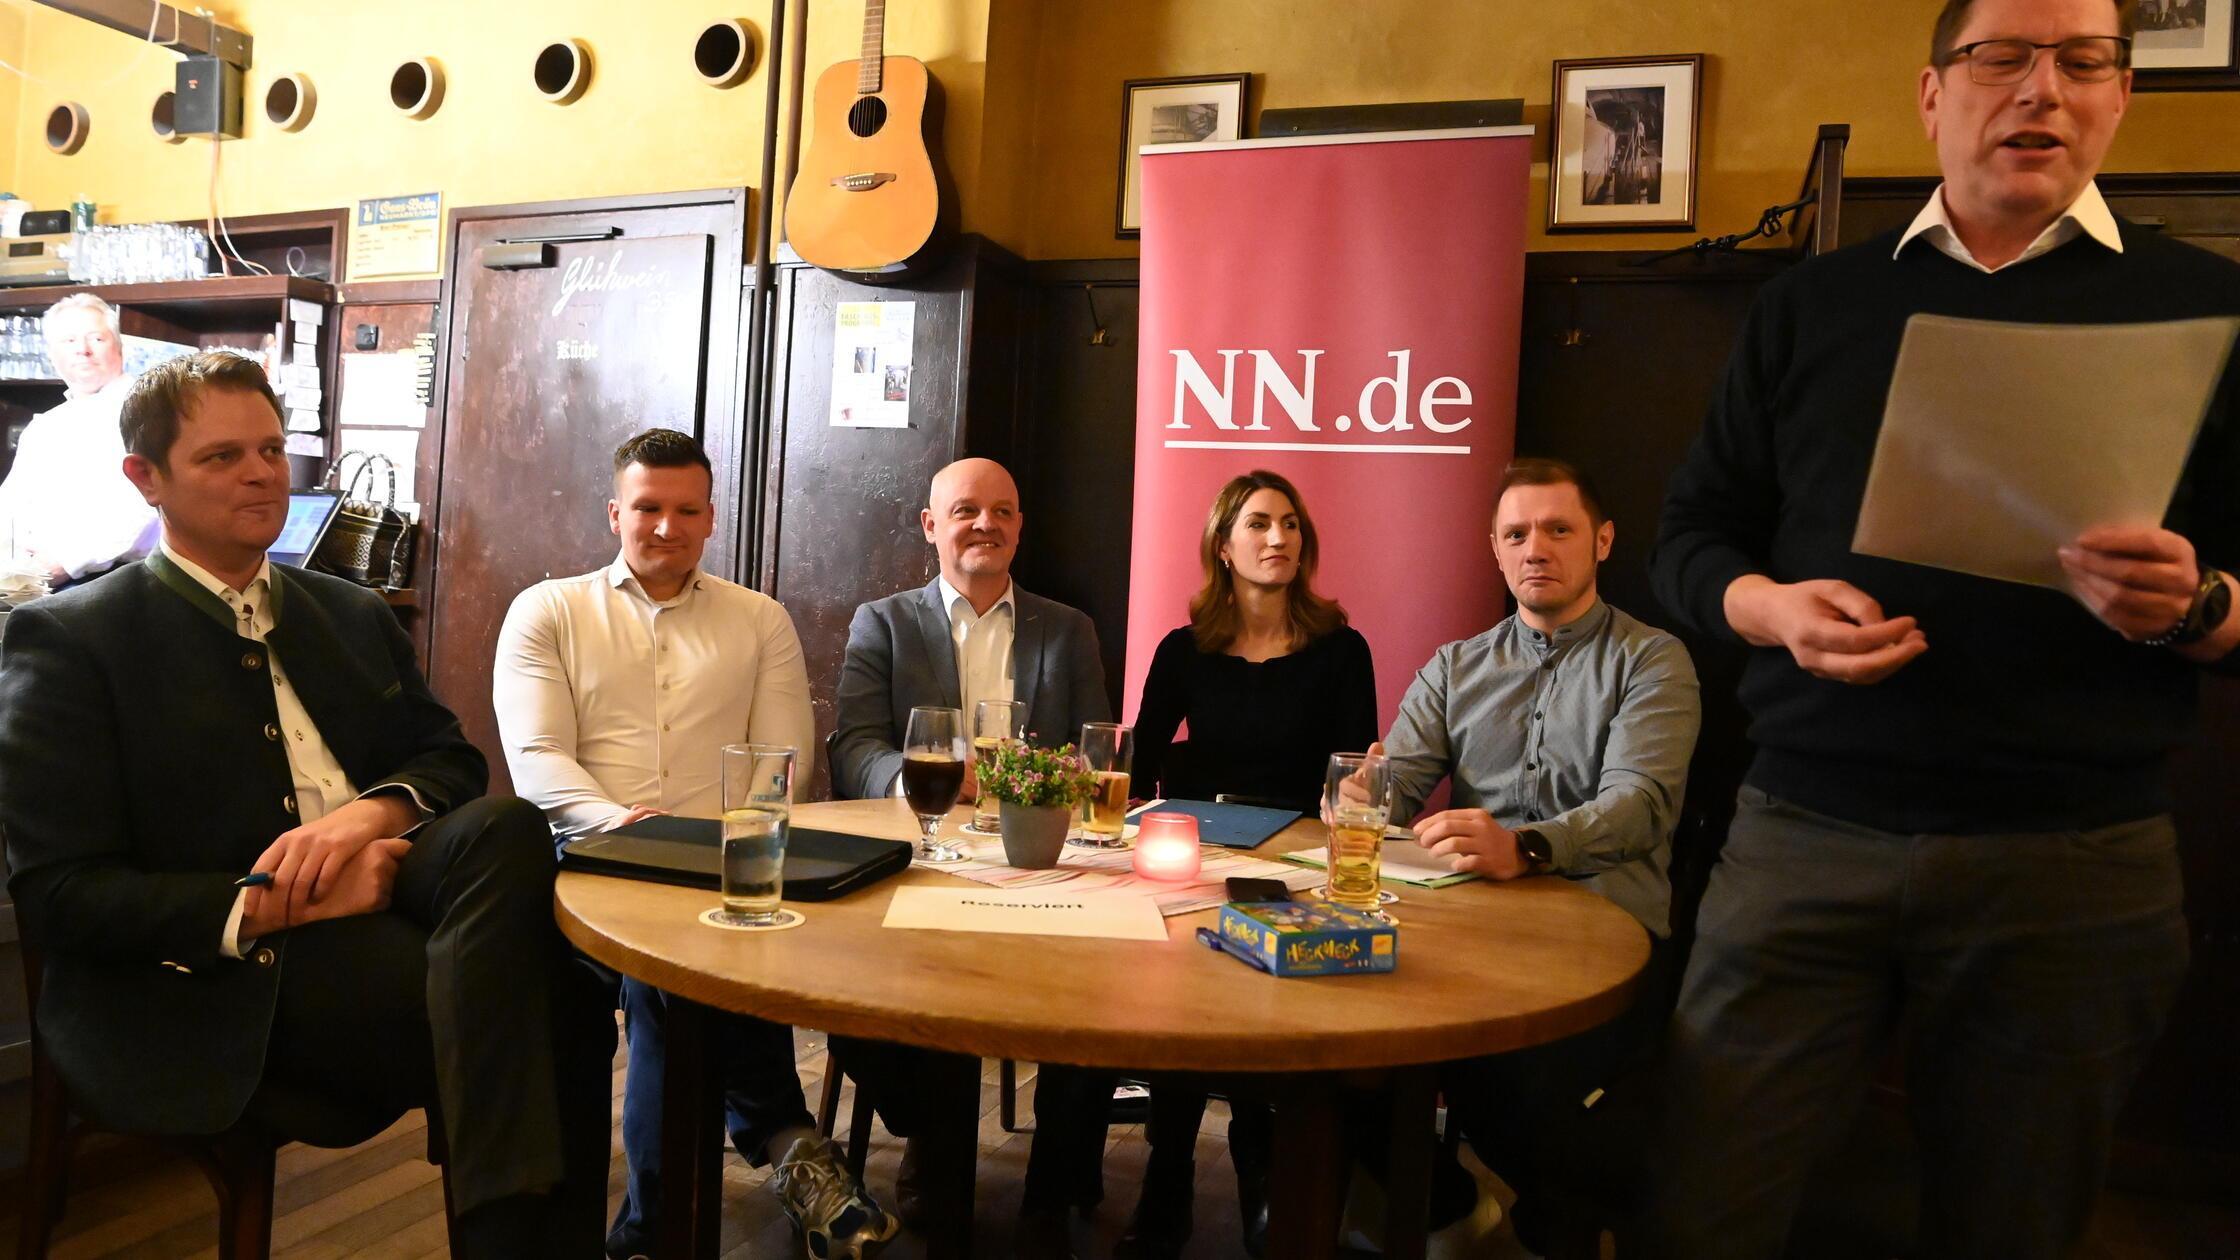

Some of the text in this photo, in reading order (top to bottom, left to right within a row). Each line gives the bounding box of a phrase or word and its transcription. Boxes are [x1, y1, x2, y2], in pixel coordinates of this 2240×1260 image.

[556, 338, 599, 361] Küche
[1164, 349, 1473, 434] NN.de
[1286, 938, 1361, 963] HECKMECK
